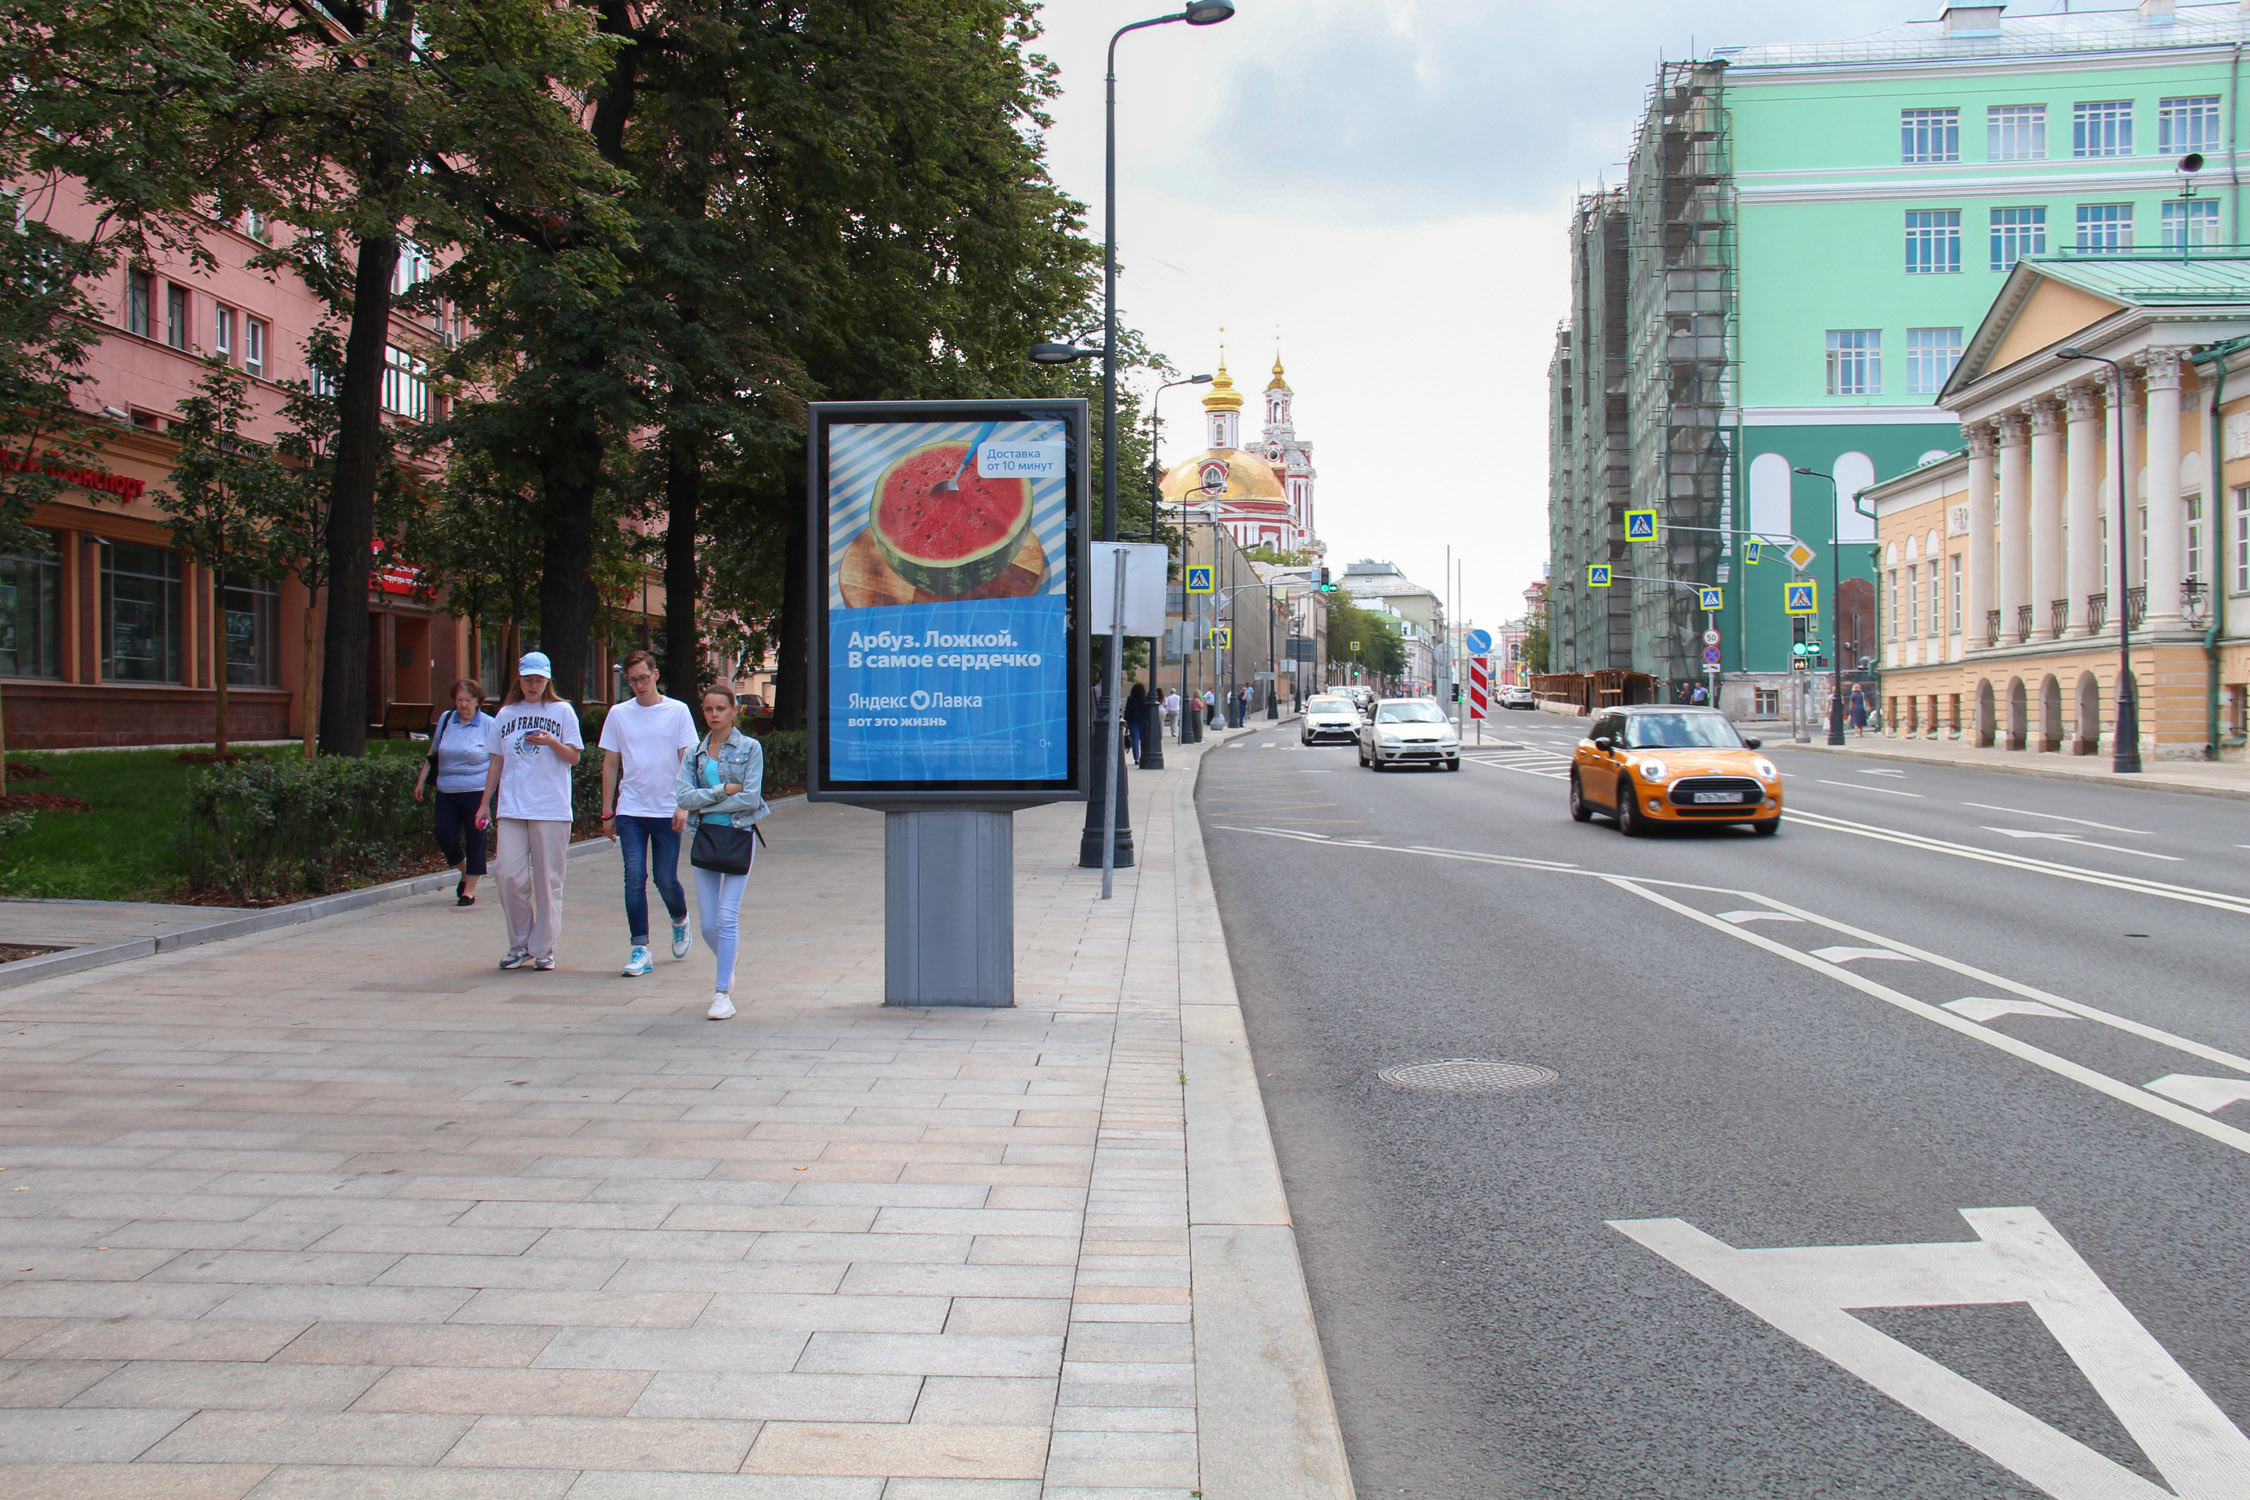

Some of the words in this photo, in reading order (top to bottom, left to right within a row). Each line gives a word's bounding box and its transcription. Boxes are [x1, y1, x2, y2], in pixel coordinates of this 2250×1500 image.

[987, 449, 1041, 460] Доставка
[987, 463, 1000, 471] от
[1003, 461, 1016, 470] 10
[1018, 463, 1053, 472] минут
[848, 630, 921, 652] Арбуз.
[924, 630, 1018, 648] Ложкой.
[1706, 634, 1717, 642] 50
[848, 651, 863, 668] В
[866, 653, 934, 668] самое
[937, 653, 1042, 671] сердечко
[849, 693, 908, 710] Яндекс
[932, 692, 983, 708] Лавка
[501, 719, 517, 739] SAN
[517, 716, 561, 737] FRANCISCO
[848, 717, 873, 727] вот
[874, 717, 899, 727] это
[901, 717, 947, 727] жизнь
[1039, 738, 1052, 748] 0+
